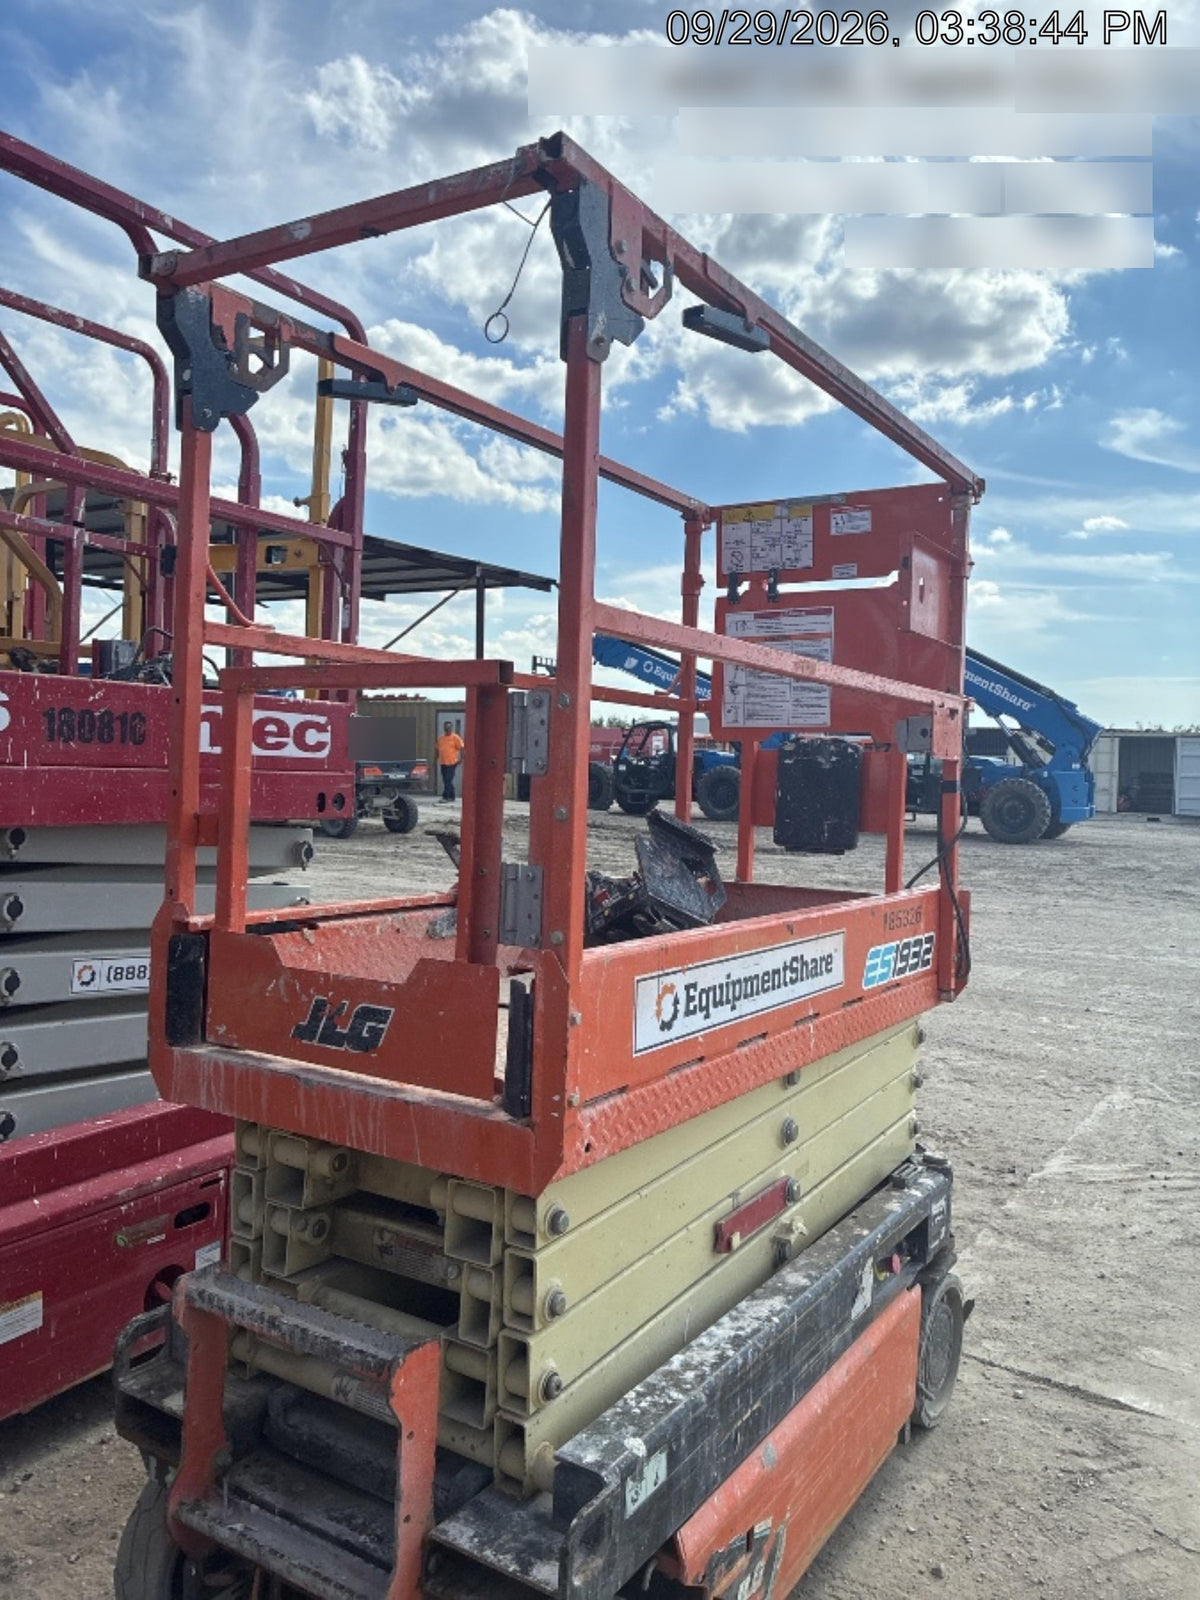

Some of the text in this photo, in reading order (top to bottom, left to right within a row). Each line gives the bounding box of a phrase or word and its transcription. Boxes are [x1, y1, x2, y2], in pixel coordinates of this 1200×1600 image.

[106, 964, 151, 984] (888
[683, 951, 834, 1020] EquipmentShare
[862, 932, 935, 990] ES1932
